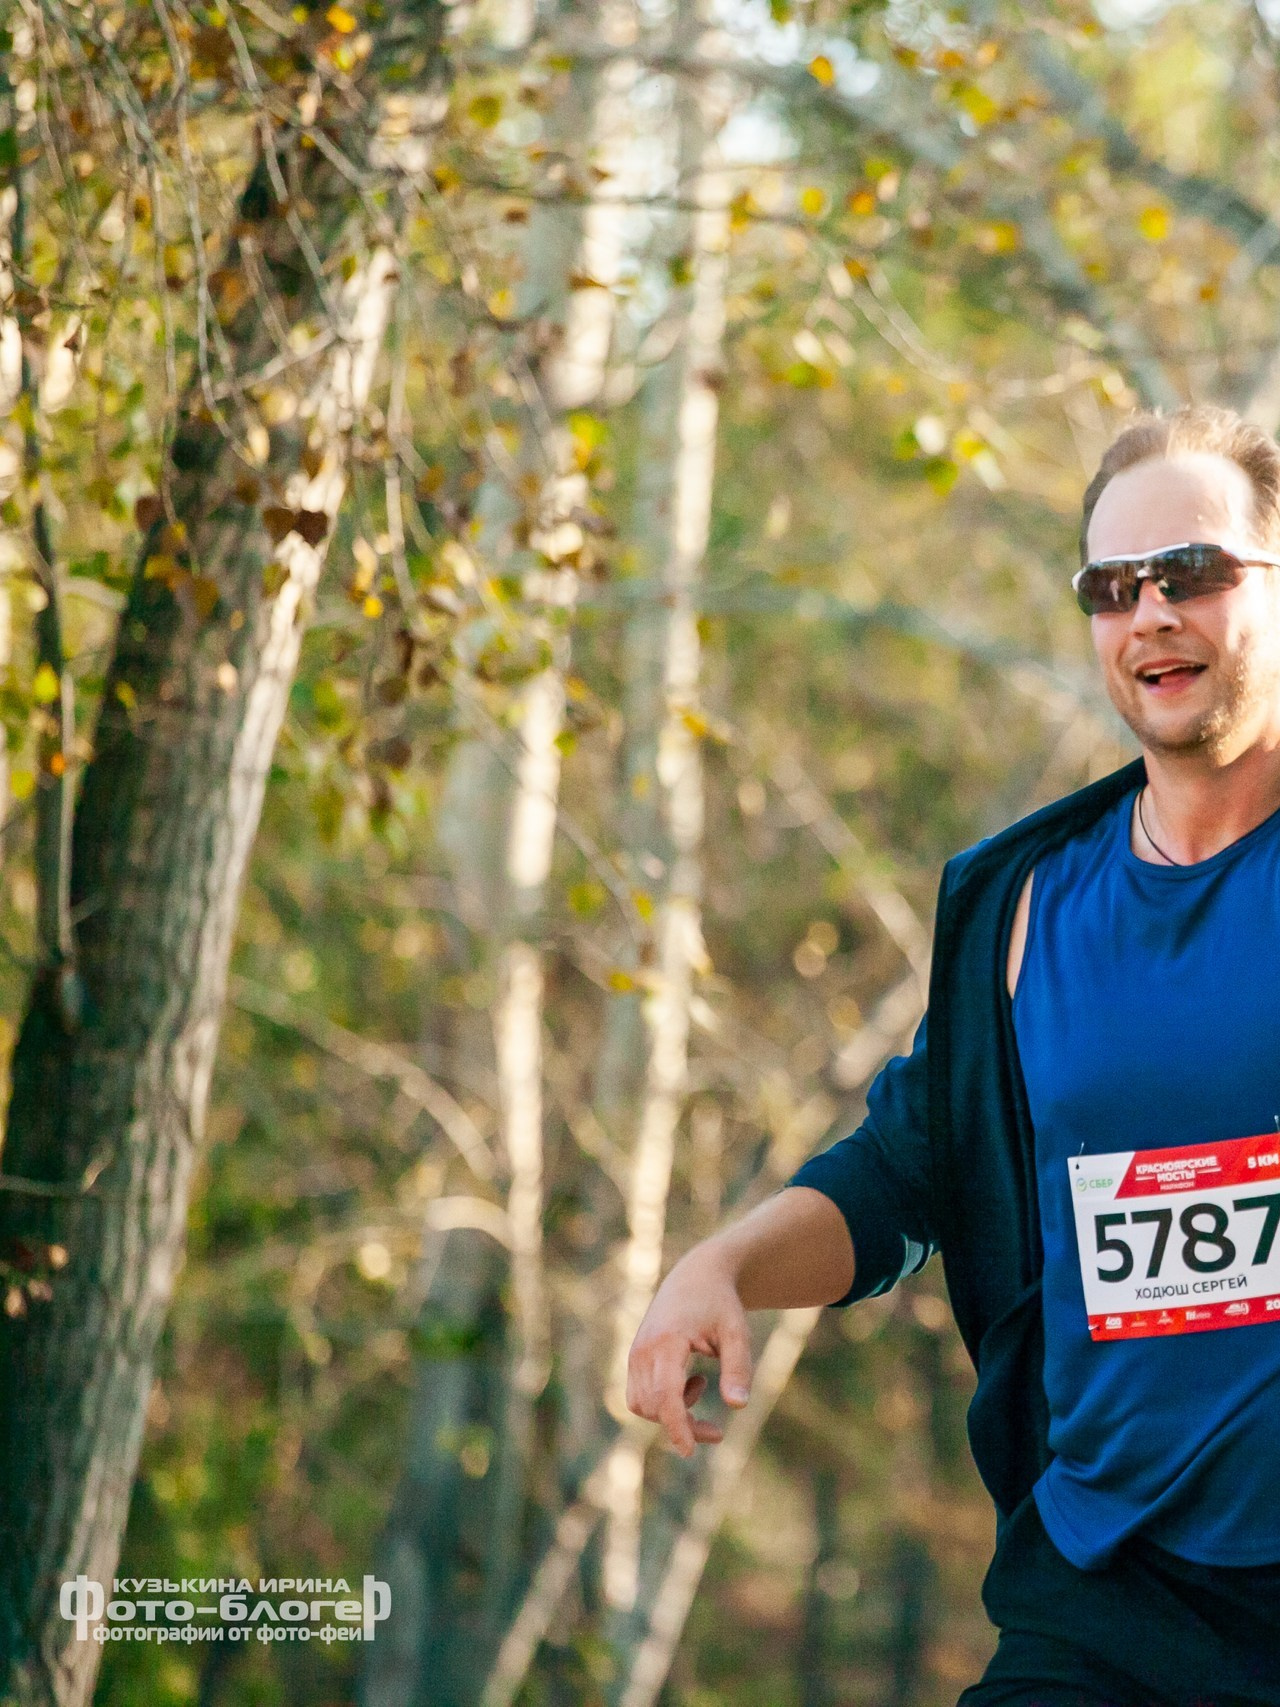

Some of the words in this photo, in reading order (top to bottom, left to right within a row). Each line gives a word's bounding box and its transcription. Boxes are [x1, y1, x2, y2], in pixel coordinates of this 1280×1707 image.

[1135, 1155, 1219, 1175] КРАСНОЯРСКИЕ
[1247, 1156, 1257, 1169] 5
[1157, 1169, 1196, 1183] МОСТЫ
[1089, 1178, 1113, 1189] СБЕР
[1135, 1282, 1190, 1300] ХОДЮШ
[1192, 1273, 1248, 1294] СЕРГЕЙ
